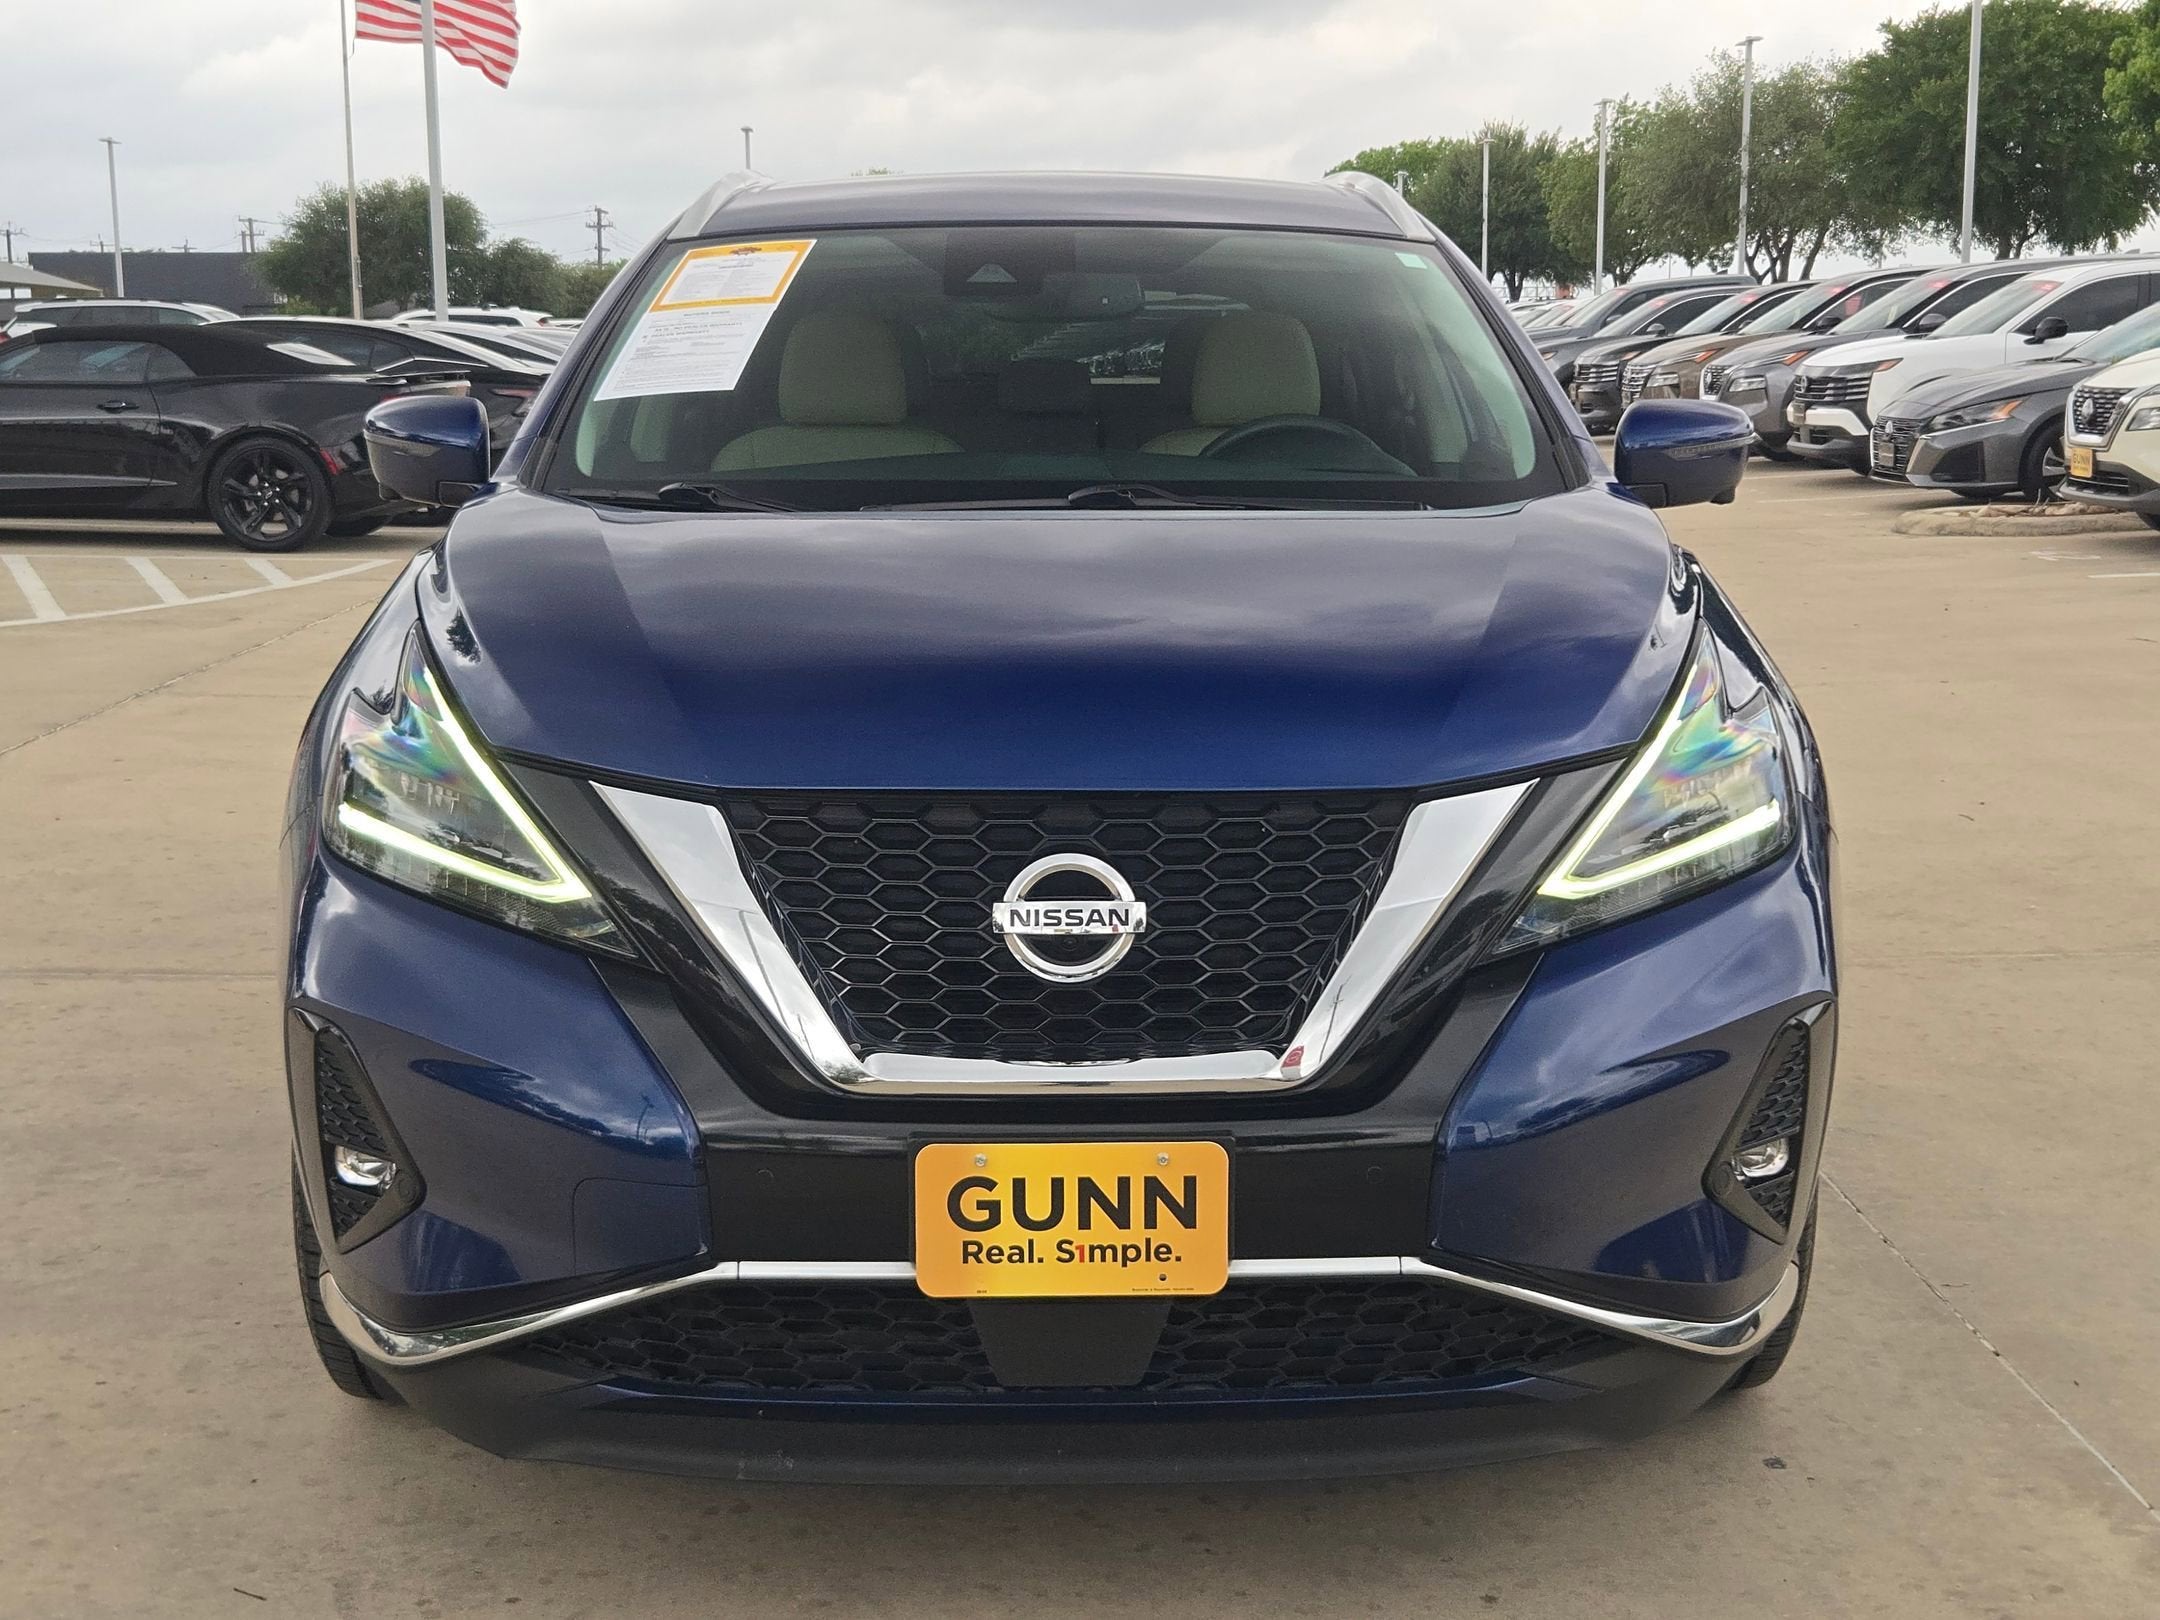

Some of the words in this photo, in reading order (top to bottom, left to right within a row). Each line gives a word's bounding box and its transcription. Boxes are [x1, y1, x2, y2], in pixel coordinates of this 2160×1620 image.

[1009, 908, 1129, 927] NISSAN
[946, 1175, 1197, 1233] GUNN
[962, 1239, 1044, 1264] Real.
